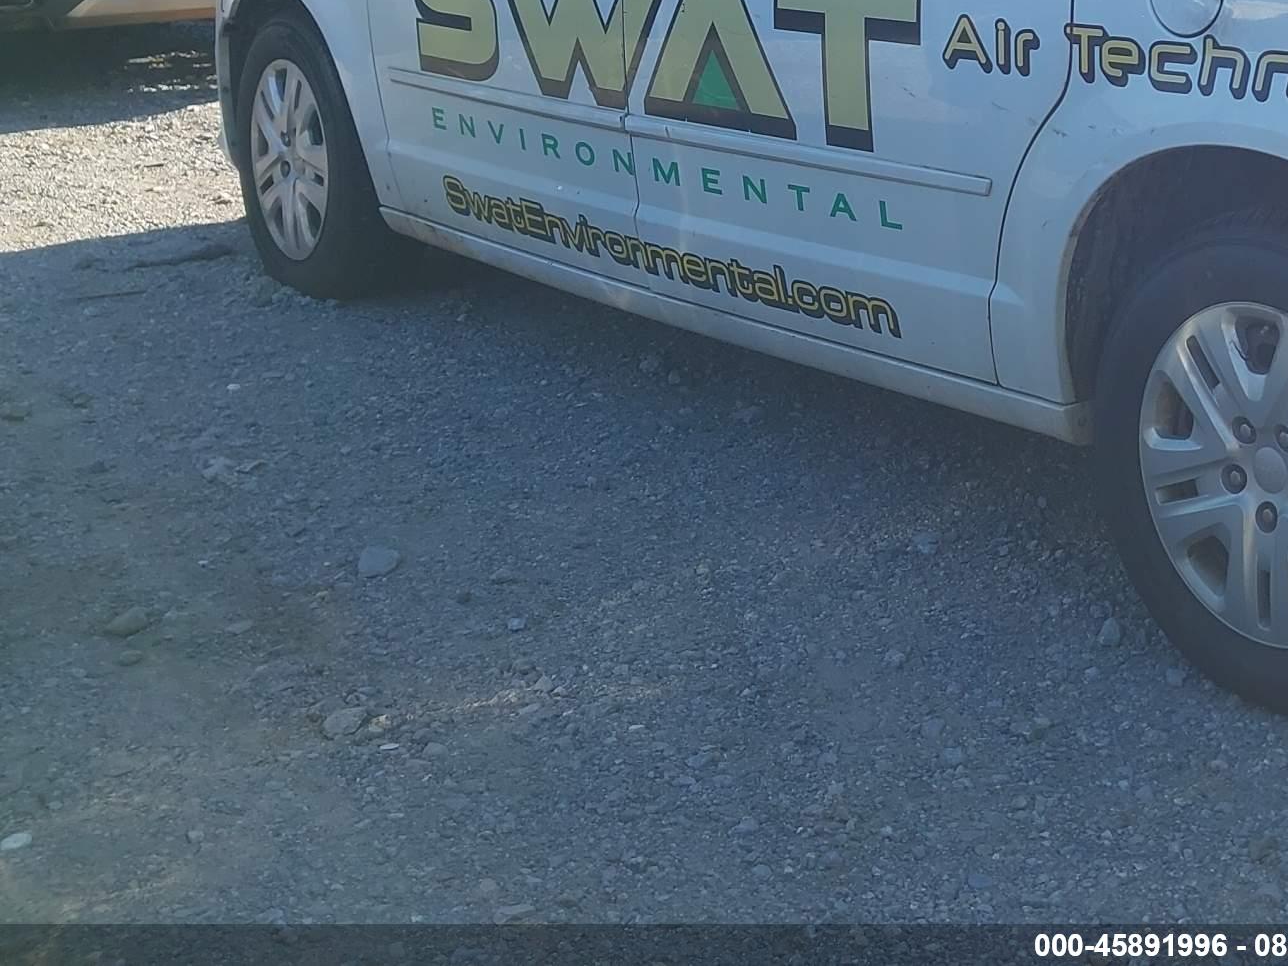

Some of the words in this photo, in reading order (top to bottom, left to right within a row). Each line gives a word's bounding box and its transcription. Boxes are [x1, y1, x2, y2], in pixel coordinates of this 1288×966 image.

[942, 14, 1040, 77] Air
[432, 107, 903, 230] ENVIRONMENTAL
[441, 175, 902, 338] SwatEnvironmental.com
